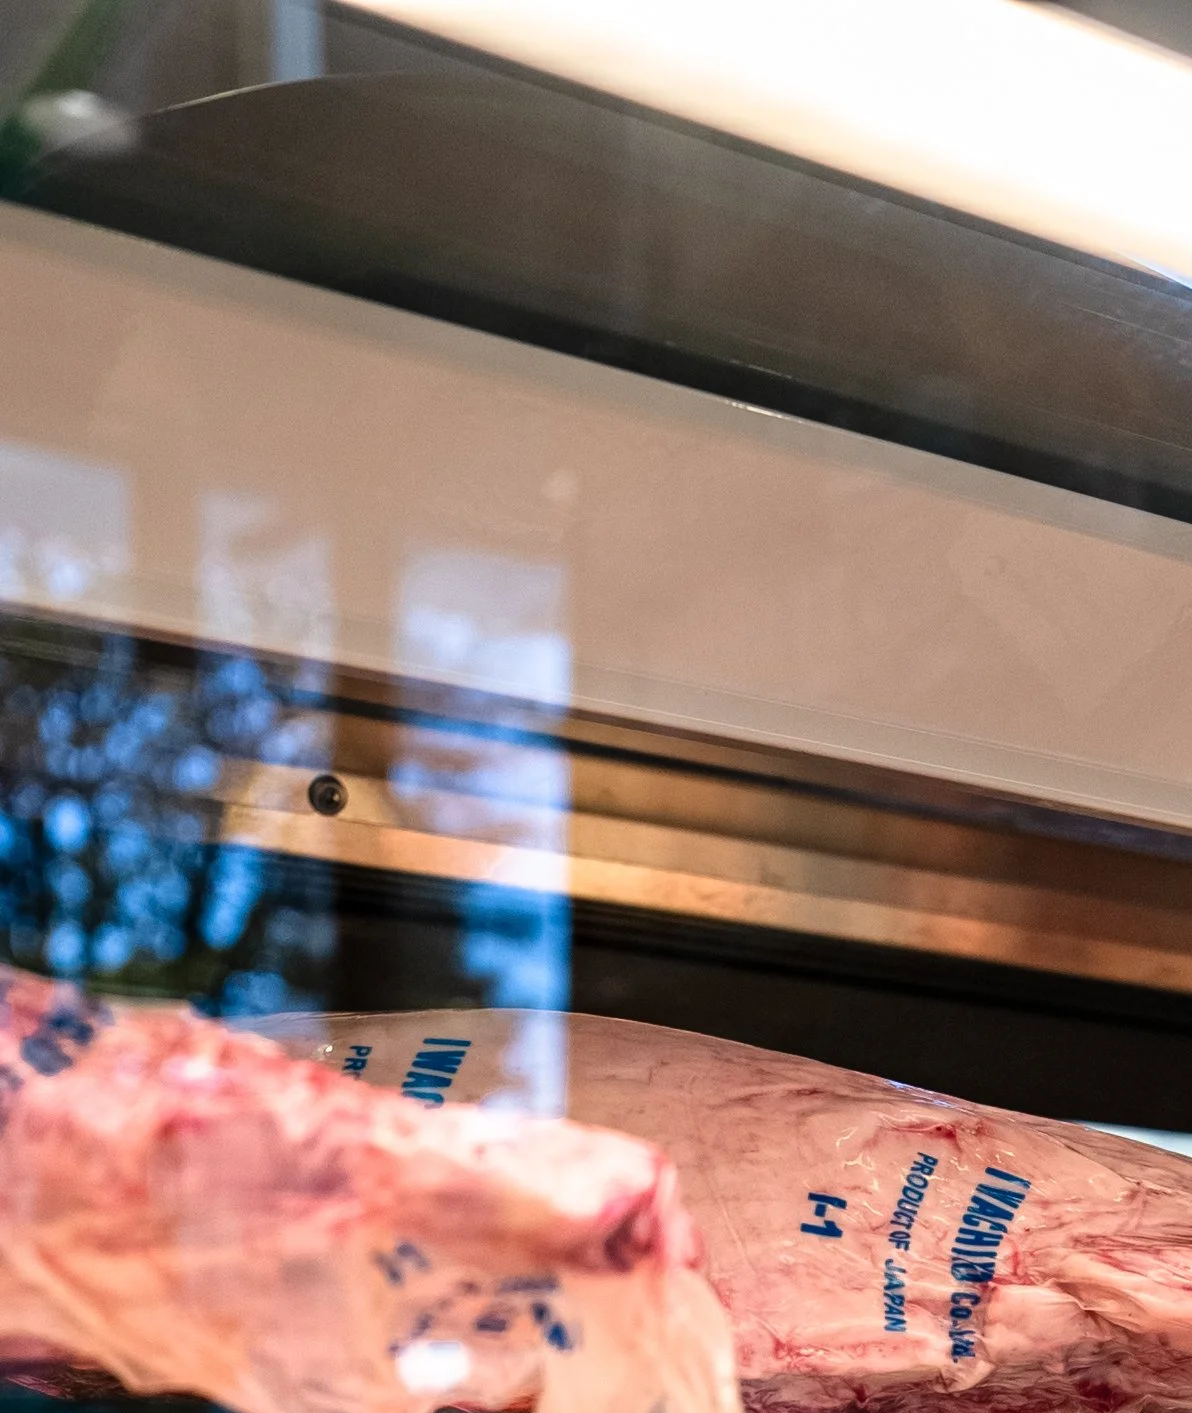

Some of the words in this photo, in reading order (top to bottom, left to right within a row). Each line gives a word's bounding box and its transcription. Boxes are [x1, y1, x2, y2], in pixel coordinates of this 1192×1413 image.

[889, 1151, 939, 1230] PRODUCT
[887, 1229, 912, 1252] OF
[884, 1257, 907, 1333] JAPAN
